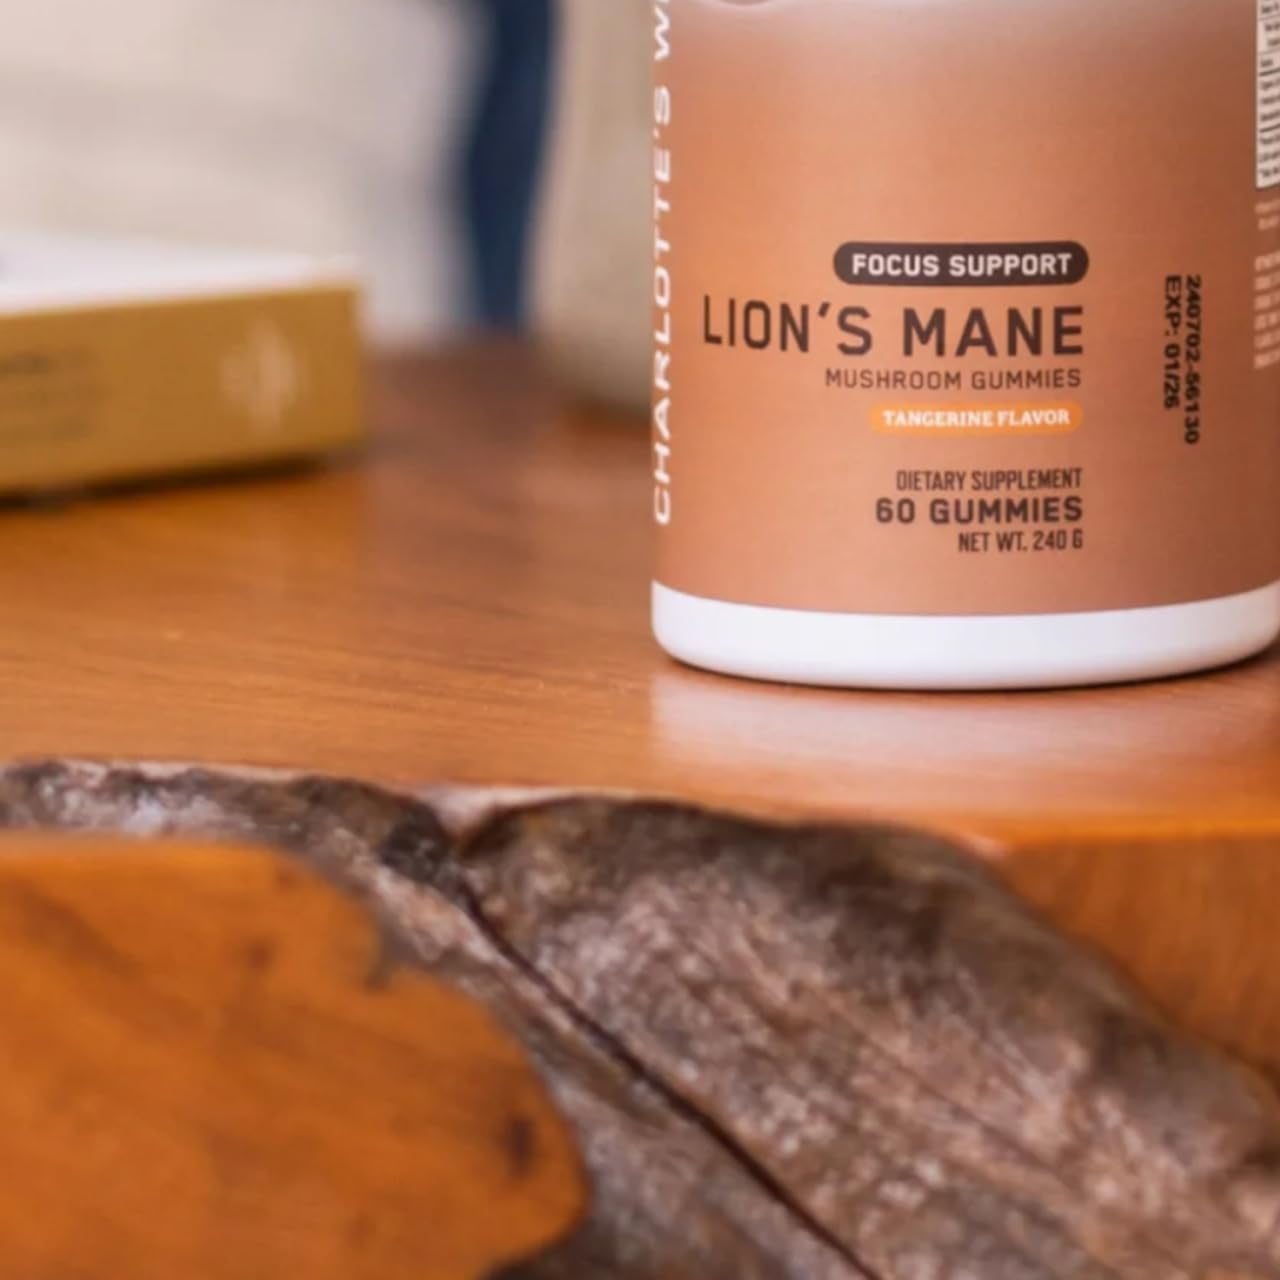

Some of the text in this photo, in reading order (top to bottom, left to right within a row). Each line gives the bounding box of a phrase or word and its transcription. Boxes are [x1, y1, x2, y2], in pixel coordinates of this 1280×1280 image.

[852, 253, 1072, 277] FOCUS SUPPORT
[653, 86, 672, 526] CHARLOTTE'S
[703, 294, 1084, 357] LION'S MANE
[1164, 275, 1181, 409] EXP: 01/26
[825, 368, 1081, 390] MUSHROOM GUMMIES
[883, 408, 1071, 427] TANGERINE FLAVOR
[896, 468, 1082, 491] DIETARY SUPPLEMENT
[875, 496, 1083, 525] 60 GUMMIES
[958, 529, 1083, 552] NET WT. 240 G
